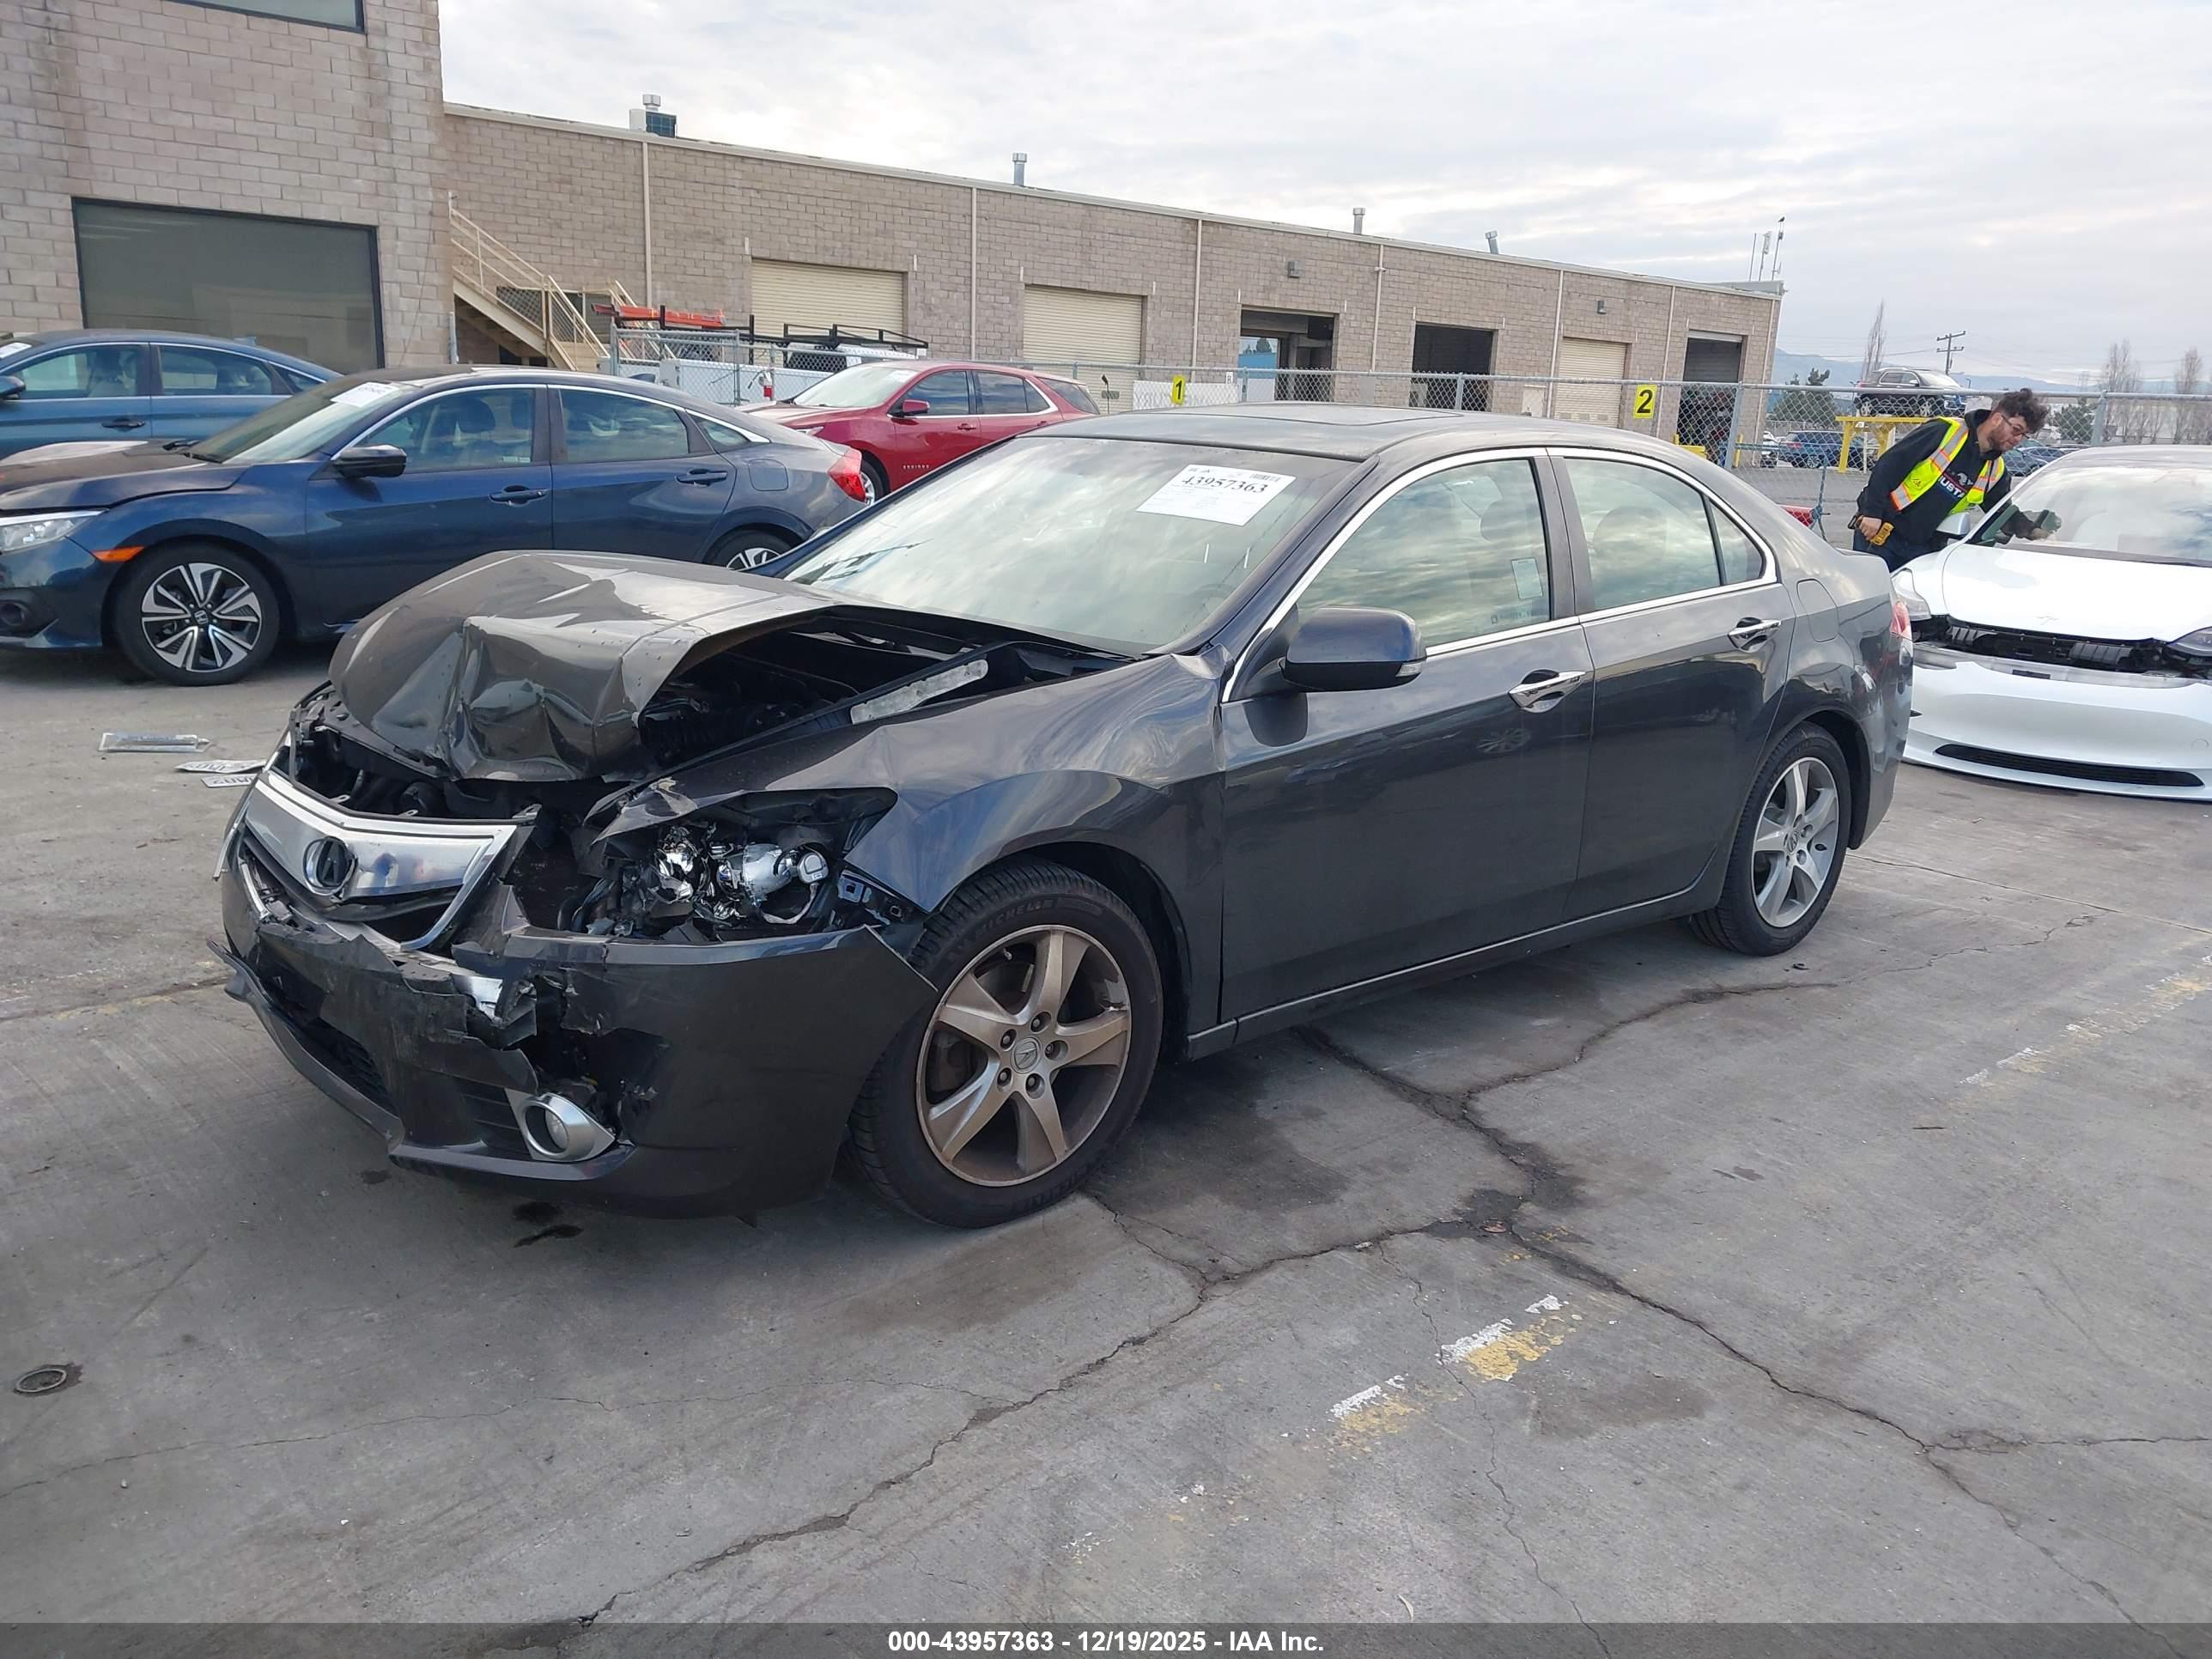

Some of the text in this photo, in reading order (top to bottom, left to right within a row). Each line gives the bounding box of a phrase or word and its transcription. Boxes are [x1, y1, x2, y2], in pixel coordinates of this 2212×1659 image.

[1175, 380, 1182, 400] 1
[1637, 389, 1653, 414] 2
[1181, 475, 1268, 494] 43957363
